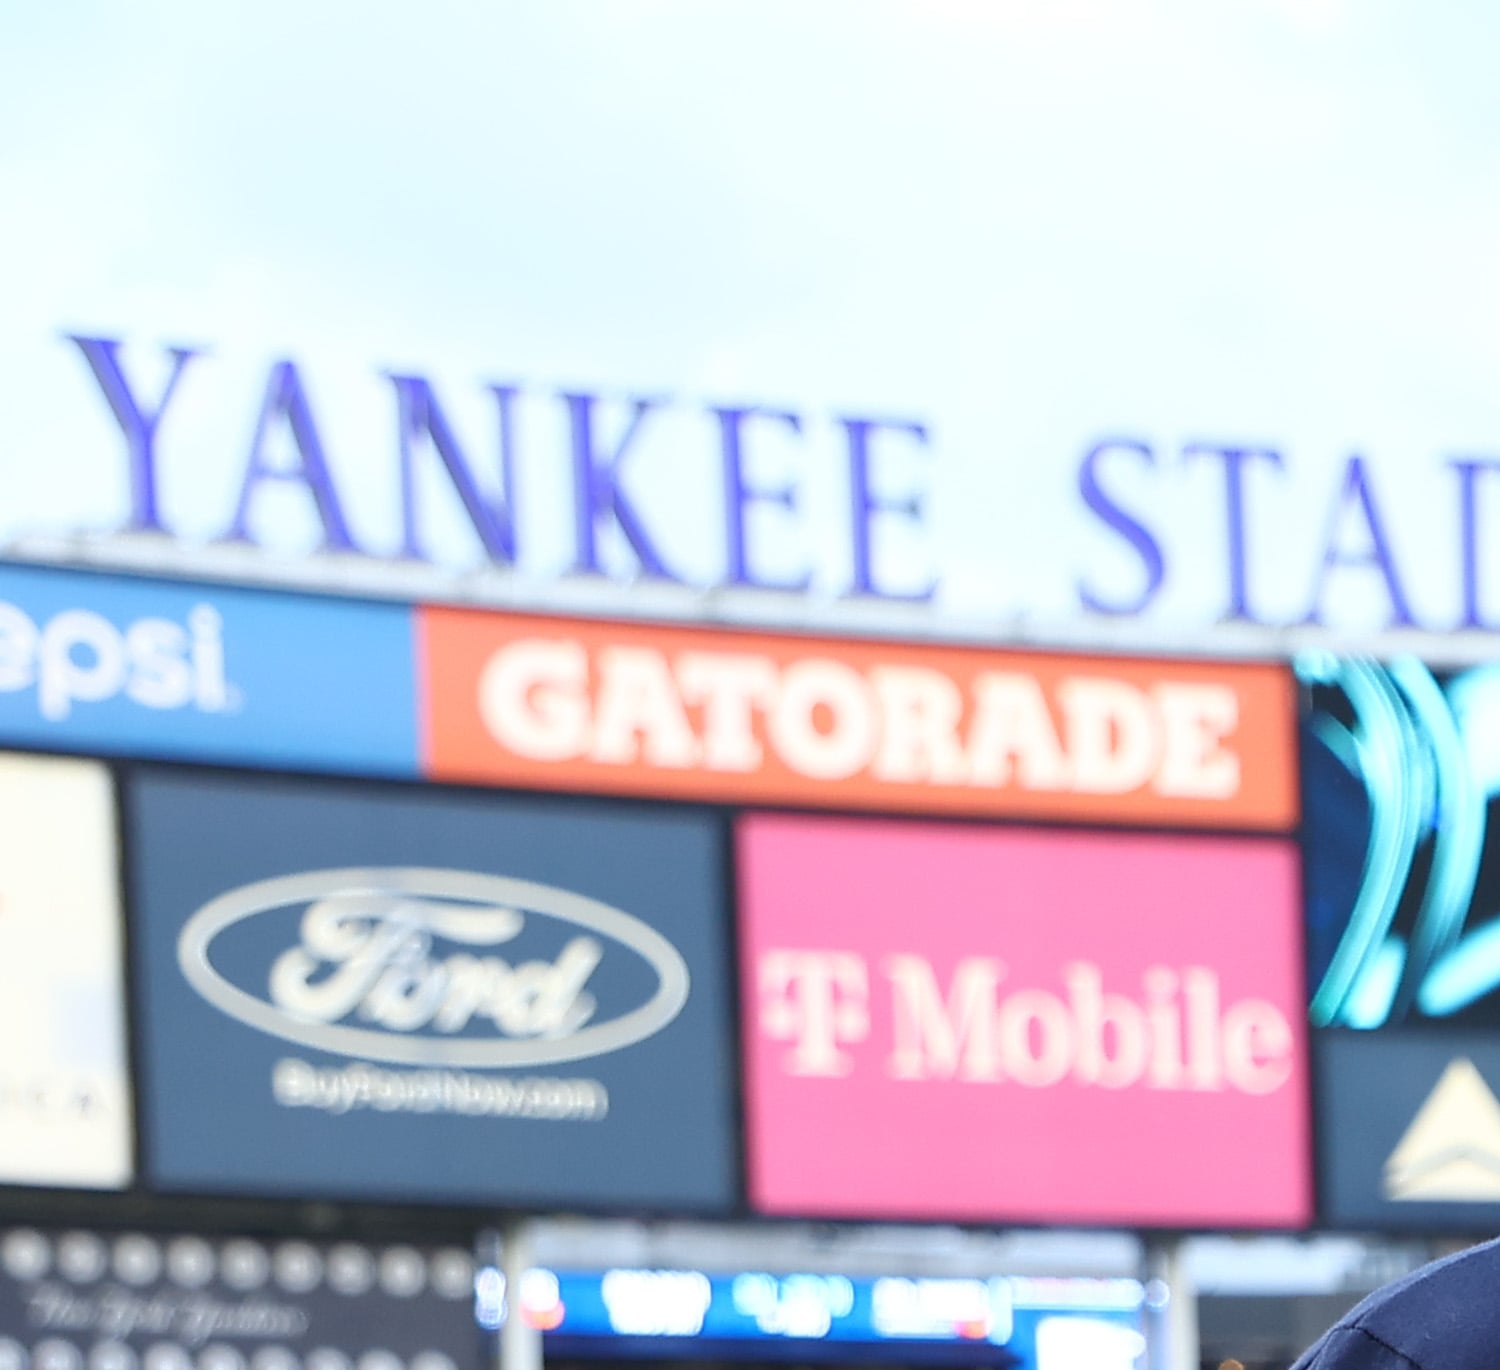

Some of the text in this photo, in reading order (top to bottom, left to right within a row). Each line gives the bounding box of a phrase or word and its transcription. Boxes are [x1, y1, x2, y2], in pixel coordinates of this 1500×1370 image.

[62, 334, 941, 602] YANKEE
[478, 637, 1240, 798] GATORADE
[270, 895, 601, 1040] Ford
[880, 952, 1294, 1095] Mobile
